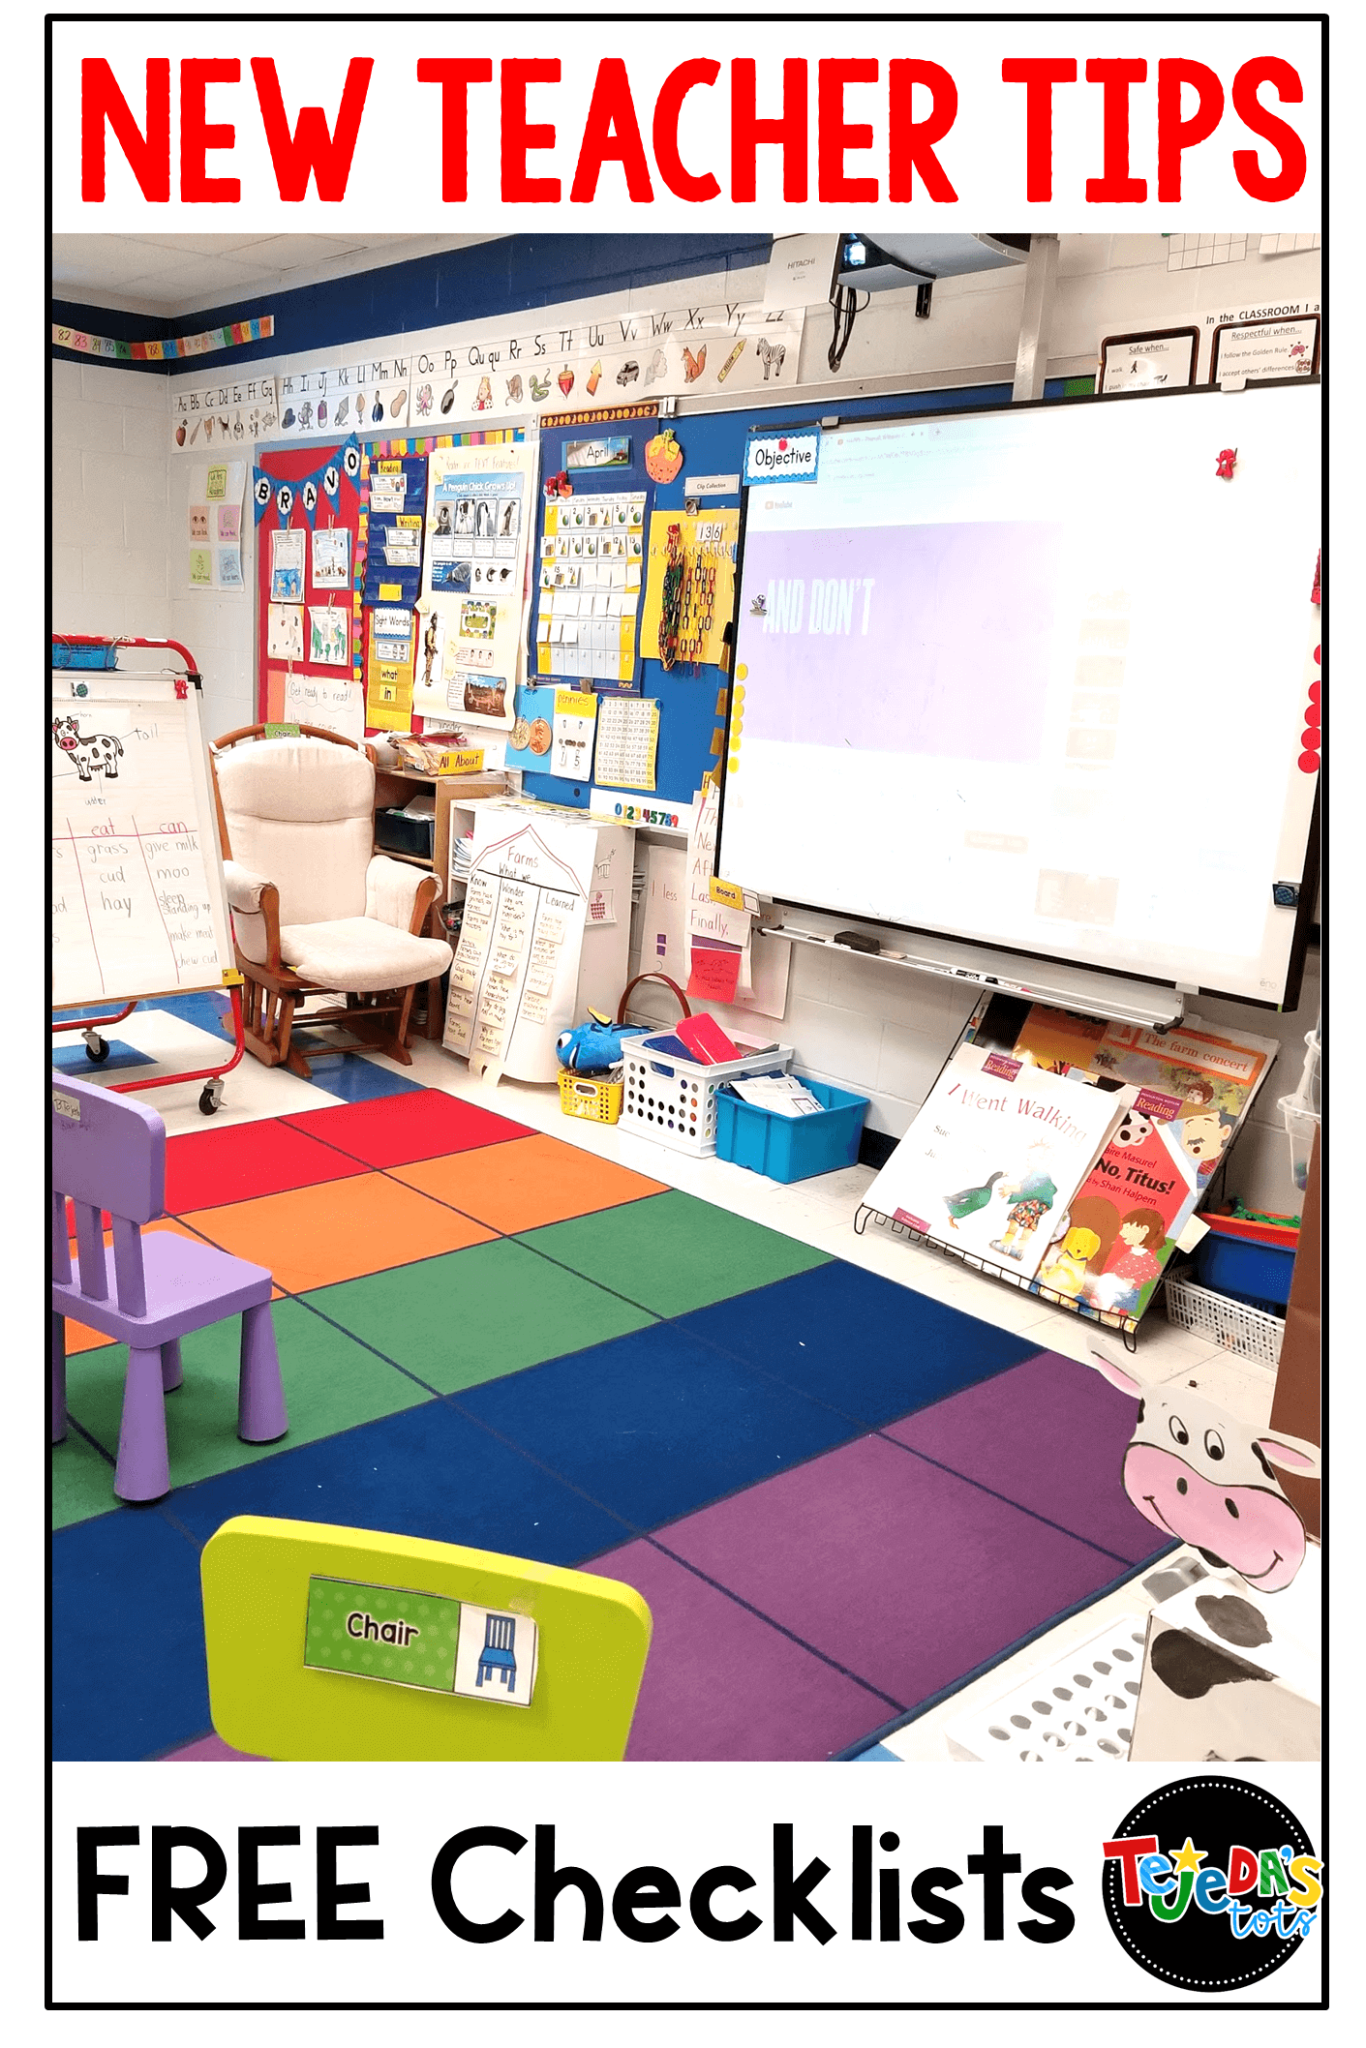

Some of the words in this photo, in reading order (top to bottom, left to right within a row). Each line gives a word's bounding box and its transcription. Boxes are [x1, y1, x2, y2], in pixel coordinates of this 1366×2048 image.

[787, 258, 815, 269] HITACHI
[1206, 316, 1215, 325] In
[1220, 313, 1234, 323] the
[1239, 305, 1300, 320] CLASSROOM
[57, 330, 71, 341] 82
[75, 334, 88, 348] 83
[419, 354, 434, 374] Oo
[445, 350, 457, 378] Pp
[468, 346, 485, 366] Qu
[488, 350, 500, 371] qu
[510, 340, 521, 359] Rr
[534, 335, 546, 356] Ss
[559, 329, 573, 352] Tt
[588, 328, 604, 347] Uu
[619, 321, 637, 342] Vv
[651, 314, 673, 335] Ww
[684, 308, 704, 330] Xx
[725, 303, 745, 337] Yy
[1232, 328, 1271, 340] Respectful
[1129, 346, 1143, 354] Safe
[1252, 347, 1273, 356] Golden
[587, 446, 608, 459] April
[755, 447, 812, 470] Objective
[448, 483, 468, 493] Penguin
[763, 580, 805, 634] AND
[808, 578, 875, 635] DON'T
[389, 615, 410, 626] Words
[382, 669, 397, 680] what
[291, 682, 301, 696] Get
[384, 687, 391, 700] in
[134, 723, 158, 740] tail
[440, 756, 449, 768] All
[455, 754, 479, 767] About
[91, 818, 115, 835] eat
[159, 821, 188, 833] can
[88, 844, 128, 863] grass
[145, 840, 169, 860] give
[175, 835, 199, 852] milk
[508, 846, 539, 868] Farms
[100, 866, 126, 884] cud
[157, 867, 190, 879] moo
[499, 862, 517, 878] What
[470, 874, 487, 887] Know
[502, 882, 525, 897] Wonder
[663, 883, 678, 901] less
[716, 886, 736, 900] Board
[101, 891, 132, 918] hay
[546, 892, 575, 911] Learned
[162, 902, 199, 919] standing
[691, 910, 729, 937] Finally,
[169, 924, 192, 941] make
[176, 953, 198, 968] chew
[202, 950, 218, 964] cud
[1144, 1032, 1166, 1048] The
[1170, 1041, 1198, 1057] farm
[1203, 1053, 1248, 1072] concert
[986, 1060, 1014, 1078] Reading
[948, 1083, 961, 1096] I
[961, 1089, 1008, 1112] Went
[1017, 1098, 1087, 1146] Walking
[1136, 1098, 1175, 1119] Reading
[1122, 1151, 1157, 1168] Masurel
[1094, 1157, 1121, 1180] No,
[1125, 1167, 1176, 1195] Titus!
[1100, 1180, 1121, 1193] Shari
[347, 1613, 419, 1646] Chair
